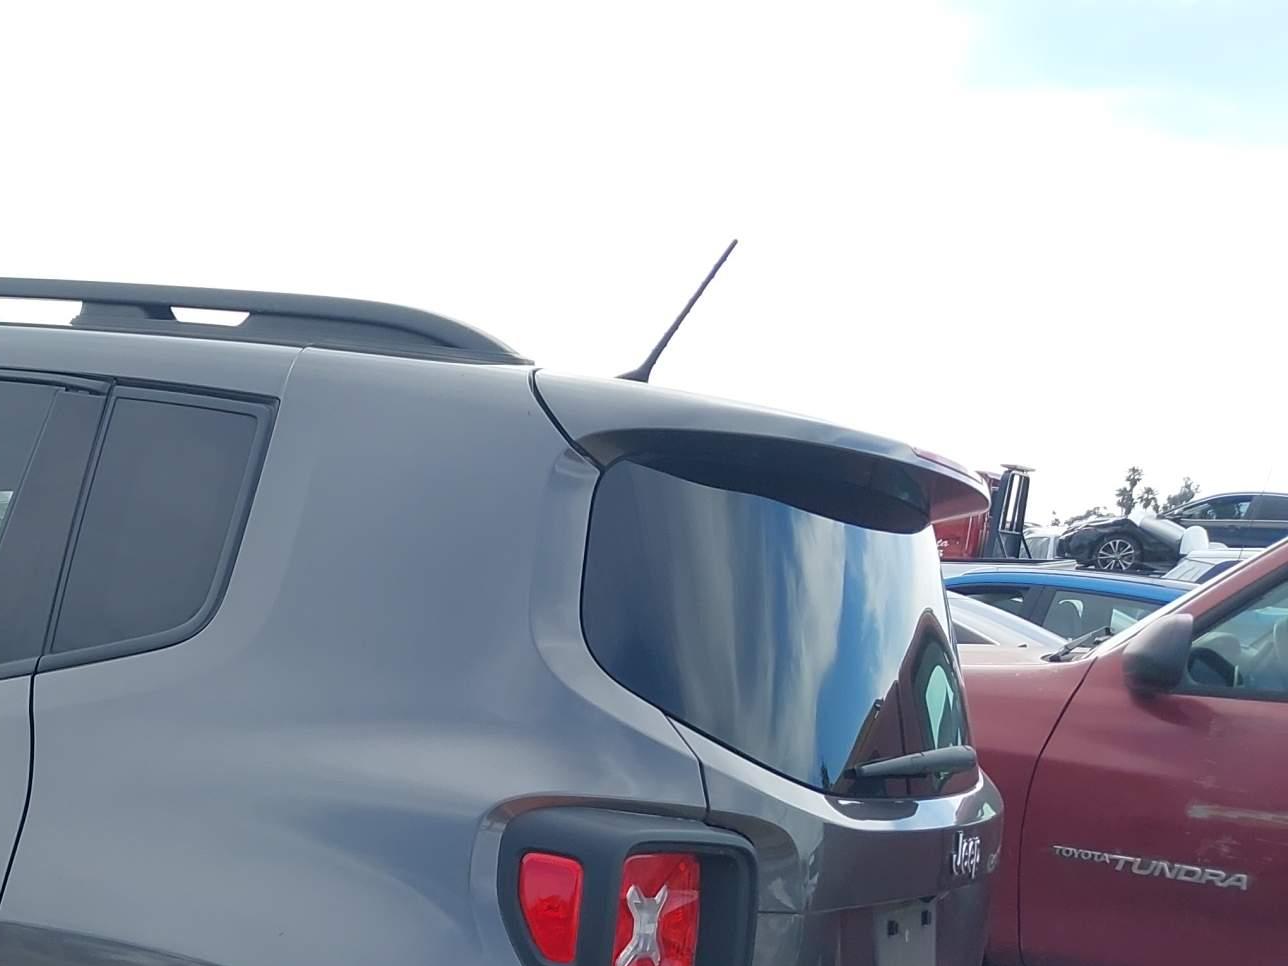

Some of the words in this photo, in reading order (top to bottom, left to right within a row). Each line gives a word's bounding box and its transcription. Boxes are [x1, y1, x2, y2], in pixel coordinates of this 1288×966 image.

[951, 829, 981, 880] Jeep
[1052, 845, 1111, 864] TOYOTA
[1108, 854, 1248, 891] TUNDRA
